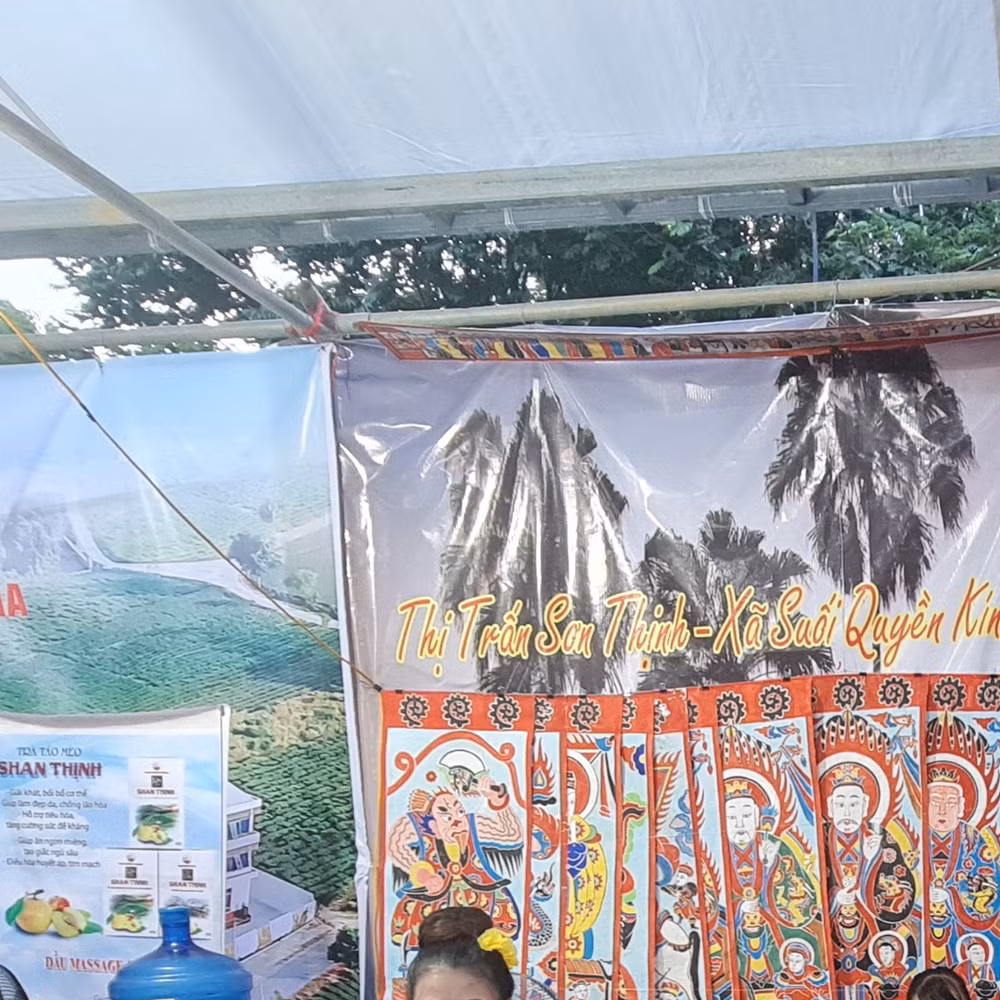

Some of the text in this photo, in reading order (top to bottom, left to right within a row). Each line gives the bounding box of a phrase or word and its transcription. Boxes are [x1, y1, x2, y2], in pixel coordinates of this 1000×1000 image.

[0, 583, 28, 617] A
[396, 596, 453, 678] Thị
[450, 593, 532, 661] Trấn
[534, 592, 596, 659] Sơn
[603, 590, 690, 670] Thịnh
[713, 583, 765, 660] Xã
[768, 583, 844, 650] Suối
[845, 582, 944, 668] Quyền
[0, 761, 102, 782] SHAN THỊNH
